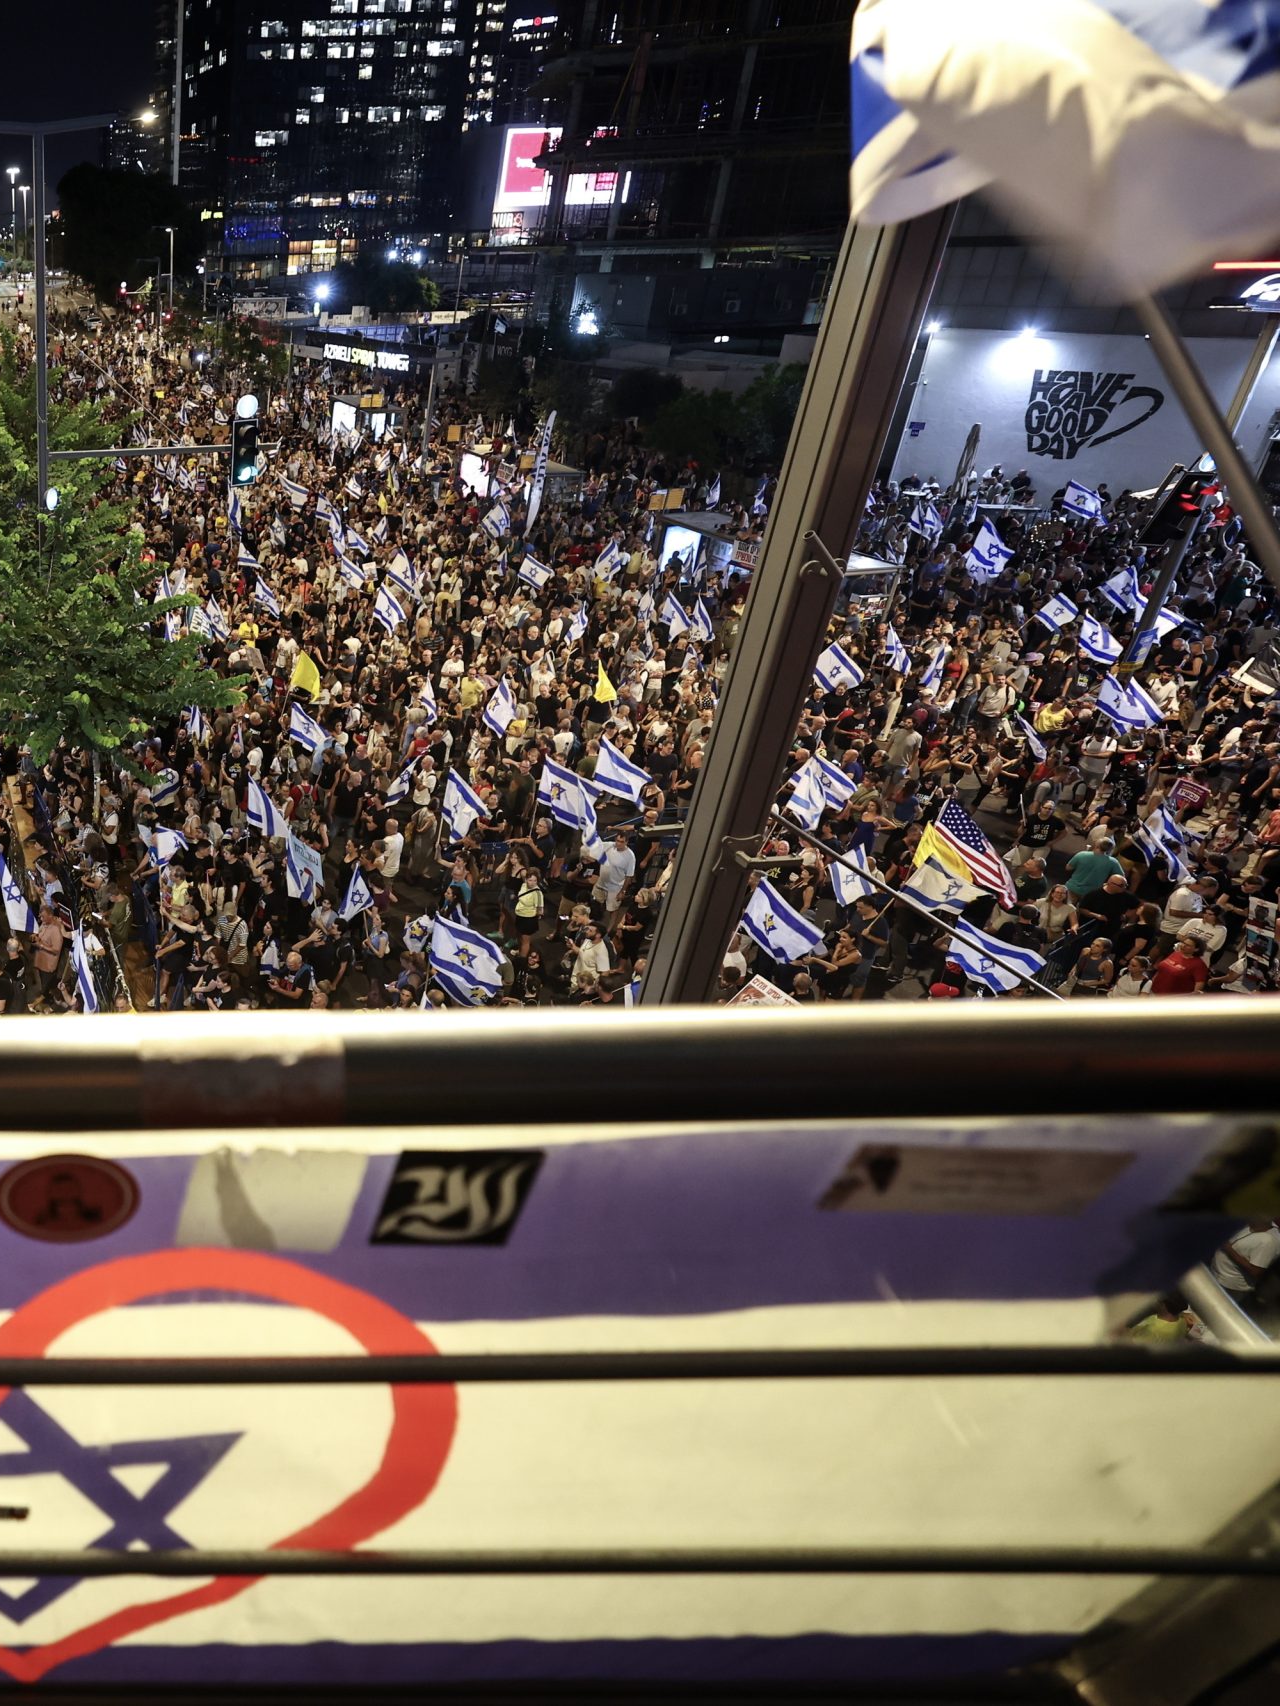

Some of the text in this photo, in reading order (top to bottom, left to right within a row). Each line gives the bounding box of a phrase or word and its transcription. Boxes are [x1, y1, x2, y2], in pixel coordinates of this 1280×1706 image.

[323, 343, 351, 362] AZRIELI
[376, 351, 409, 371] TOWER
[1025, 400, 1109, 438] GOOD
[1027, 430, 1093, 460] DAY
